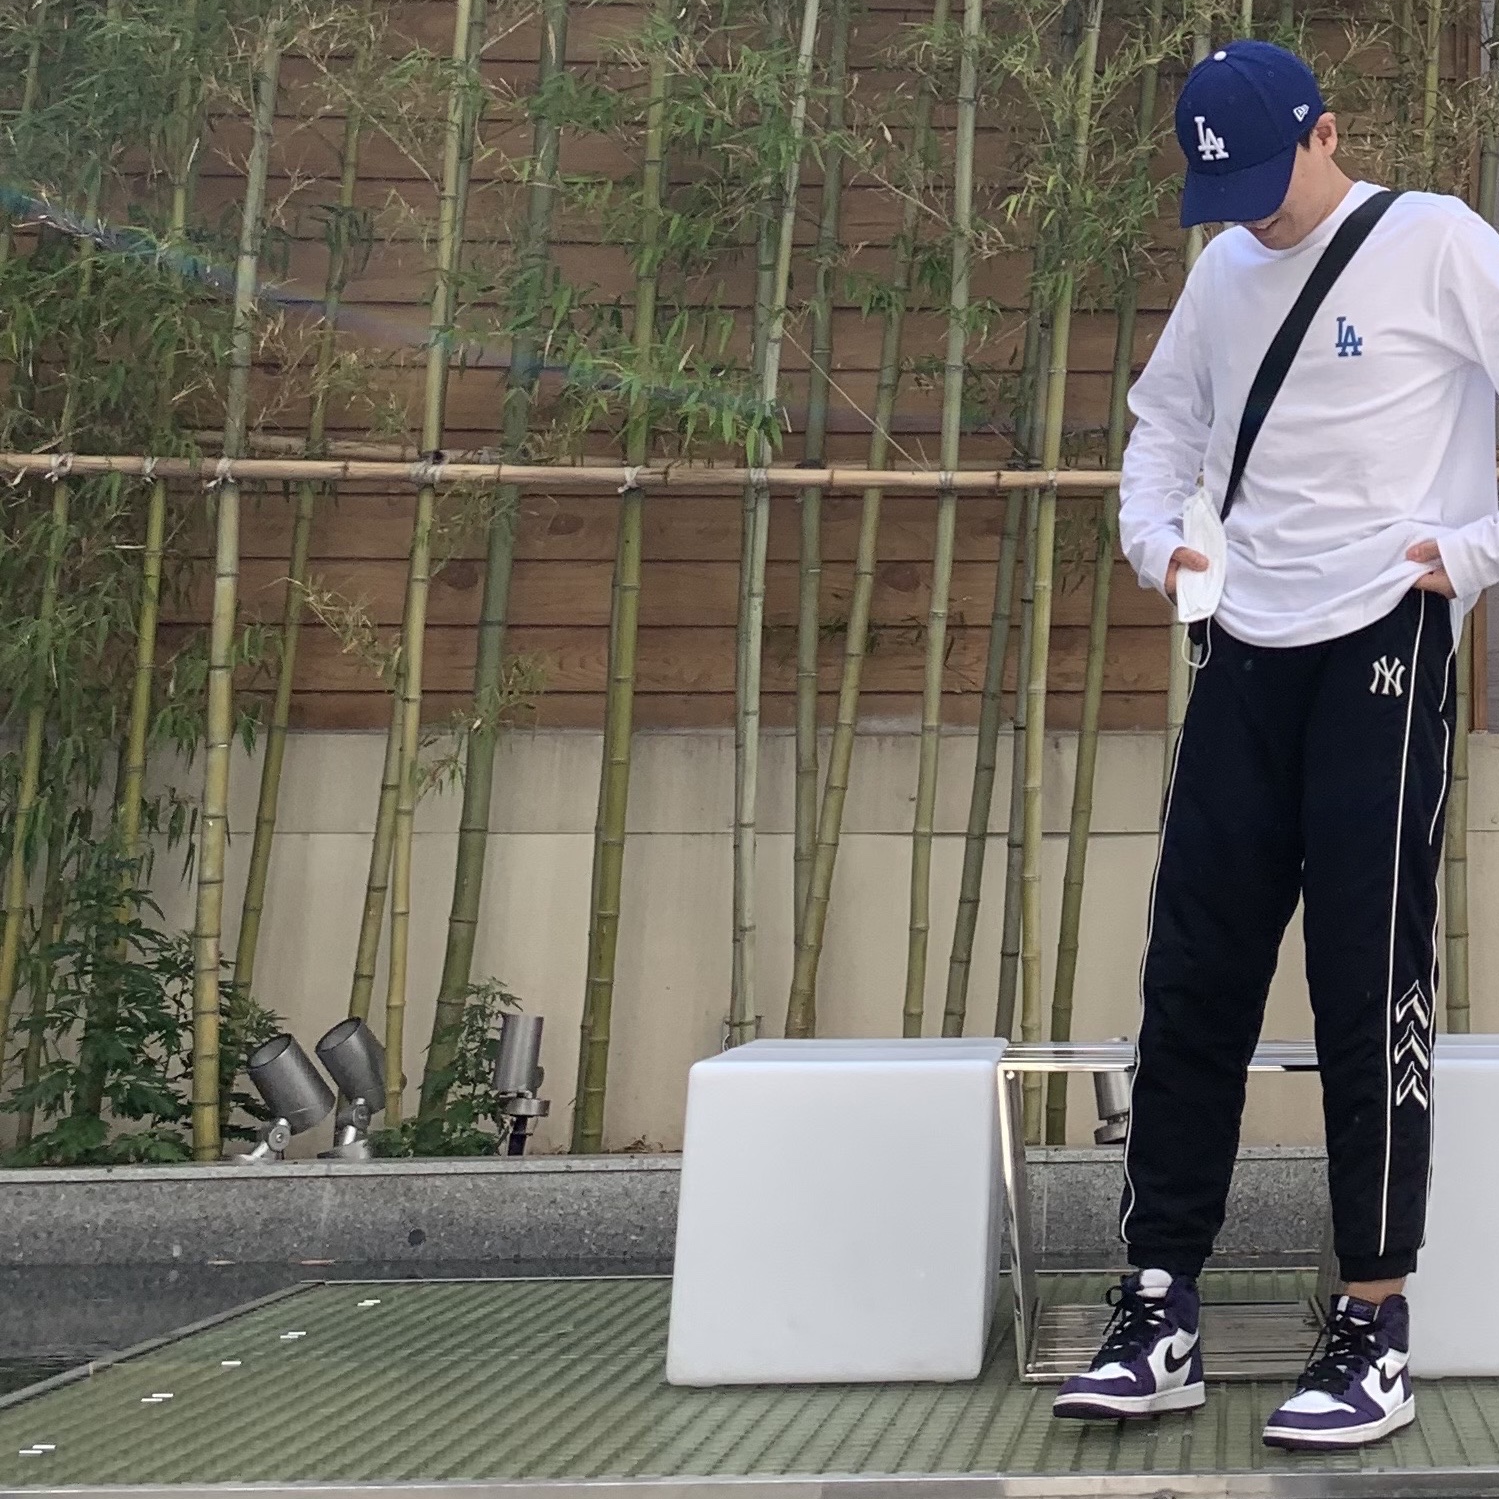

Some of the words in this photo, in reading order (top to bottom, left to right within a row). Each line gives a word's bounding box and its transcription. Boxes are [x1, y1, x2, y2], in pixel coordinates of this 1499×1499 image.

[1194, 116, 1230, 161] LA
[1335, 316, 1363, 357] LA
[1369, 655, 1406, 697] NY
